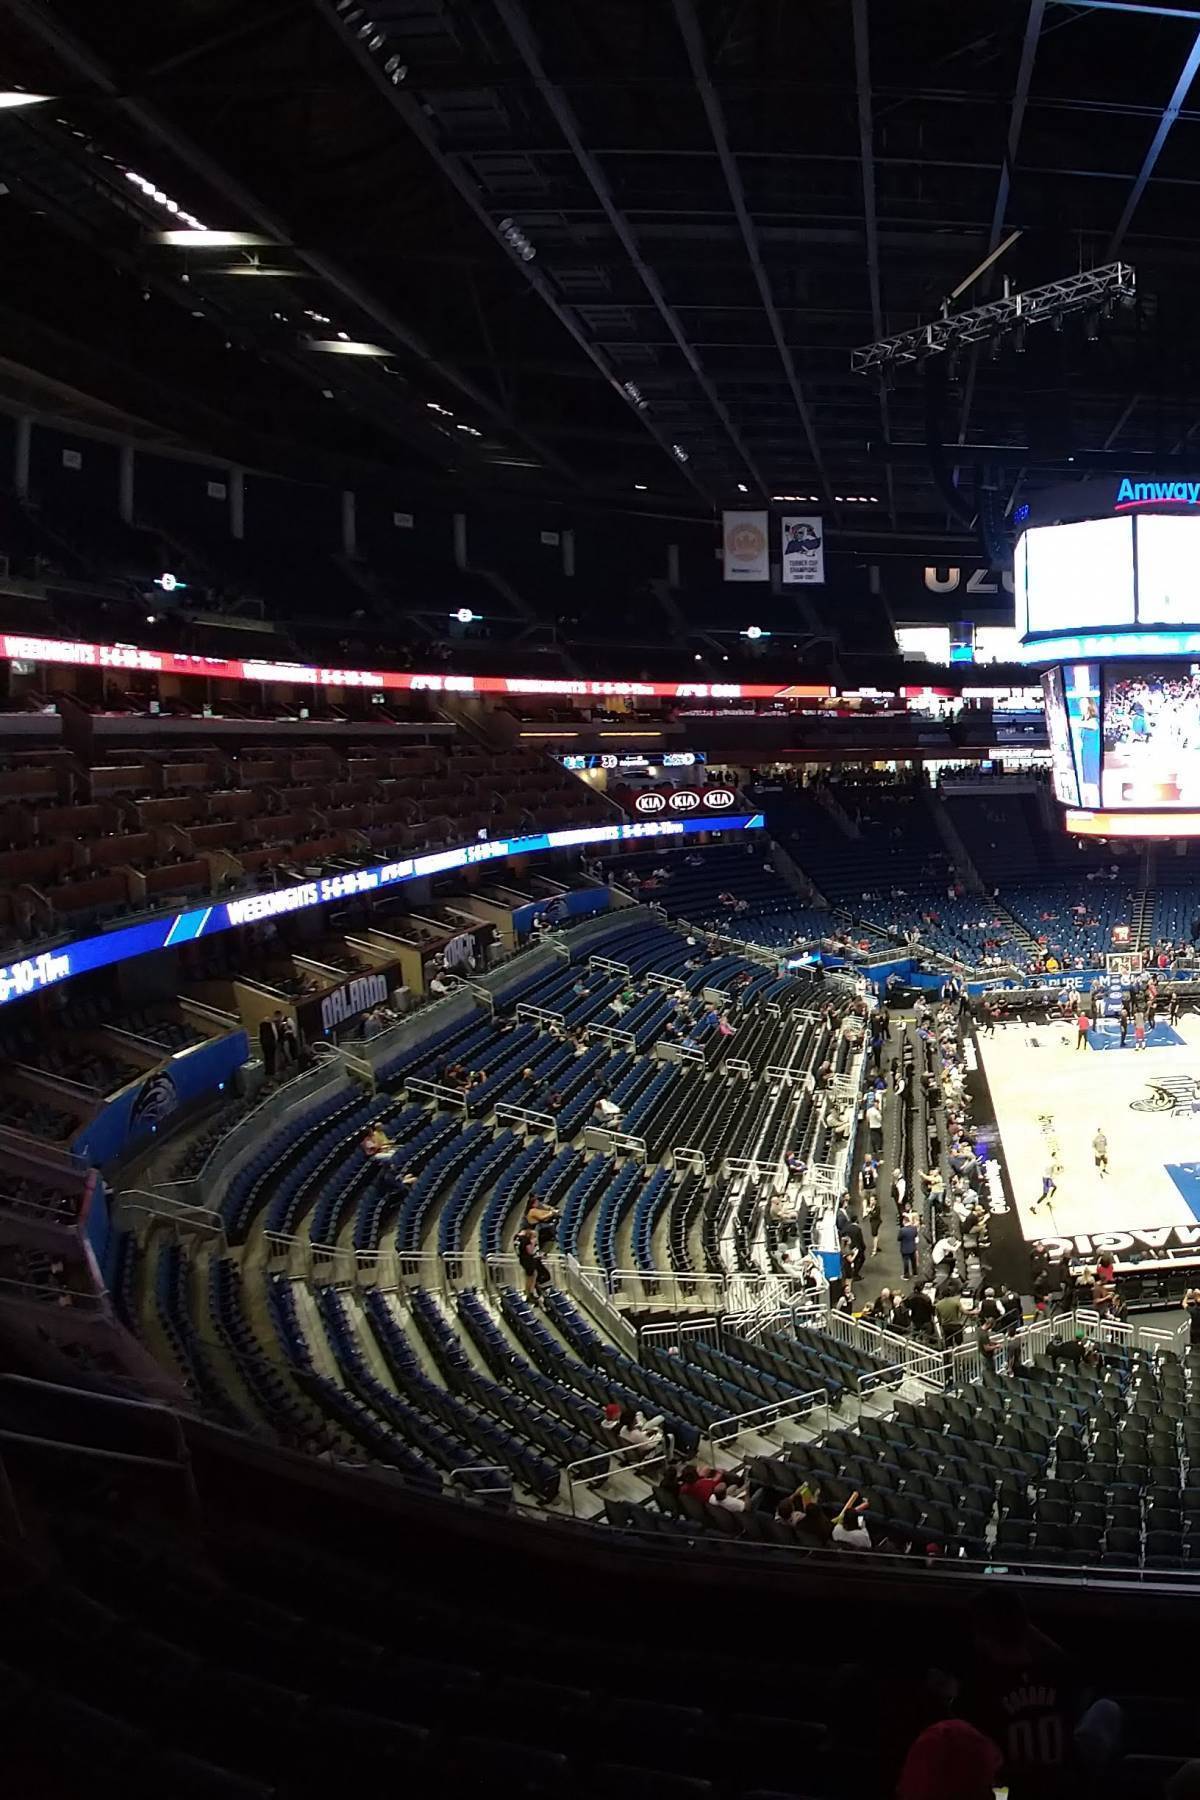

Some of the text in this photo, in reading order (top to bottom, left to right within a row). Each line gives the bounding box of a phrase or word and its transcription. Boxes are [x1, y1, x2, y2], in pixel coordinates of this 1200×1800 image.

[1117, 478, 1200, 504] Amway
[642, 797, 660, 809] KIA
[675, 795, 694, 806] KIA
[709, 793, 728, 804] KIA
[226, 882, 318, 926] WEEKNIGHTS
[321, 974, 388, 1029] ORLANDO
